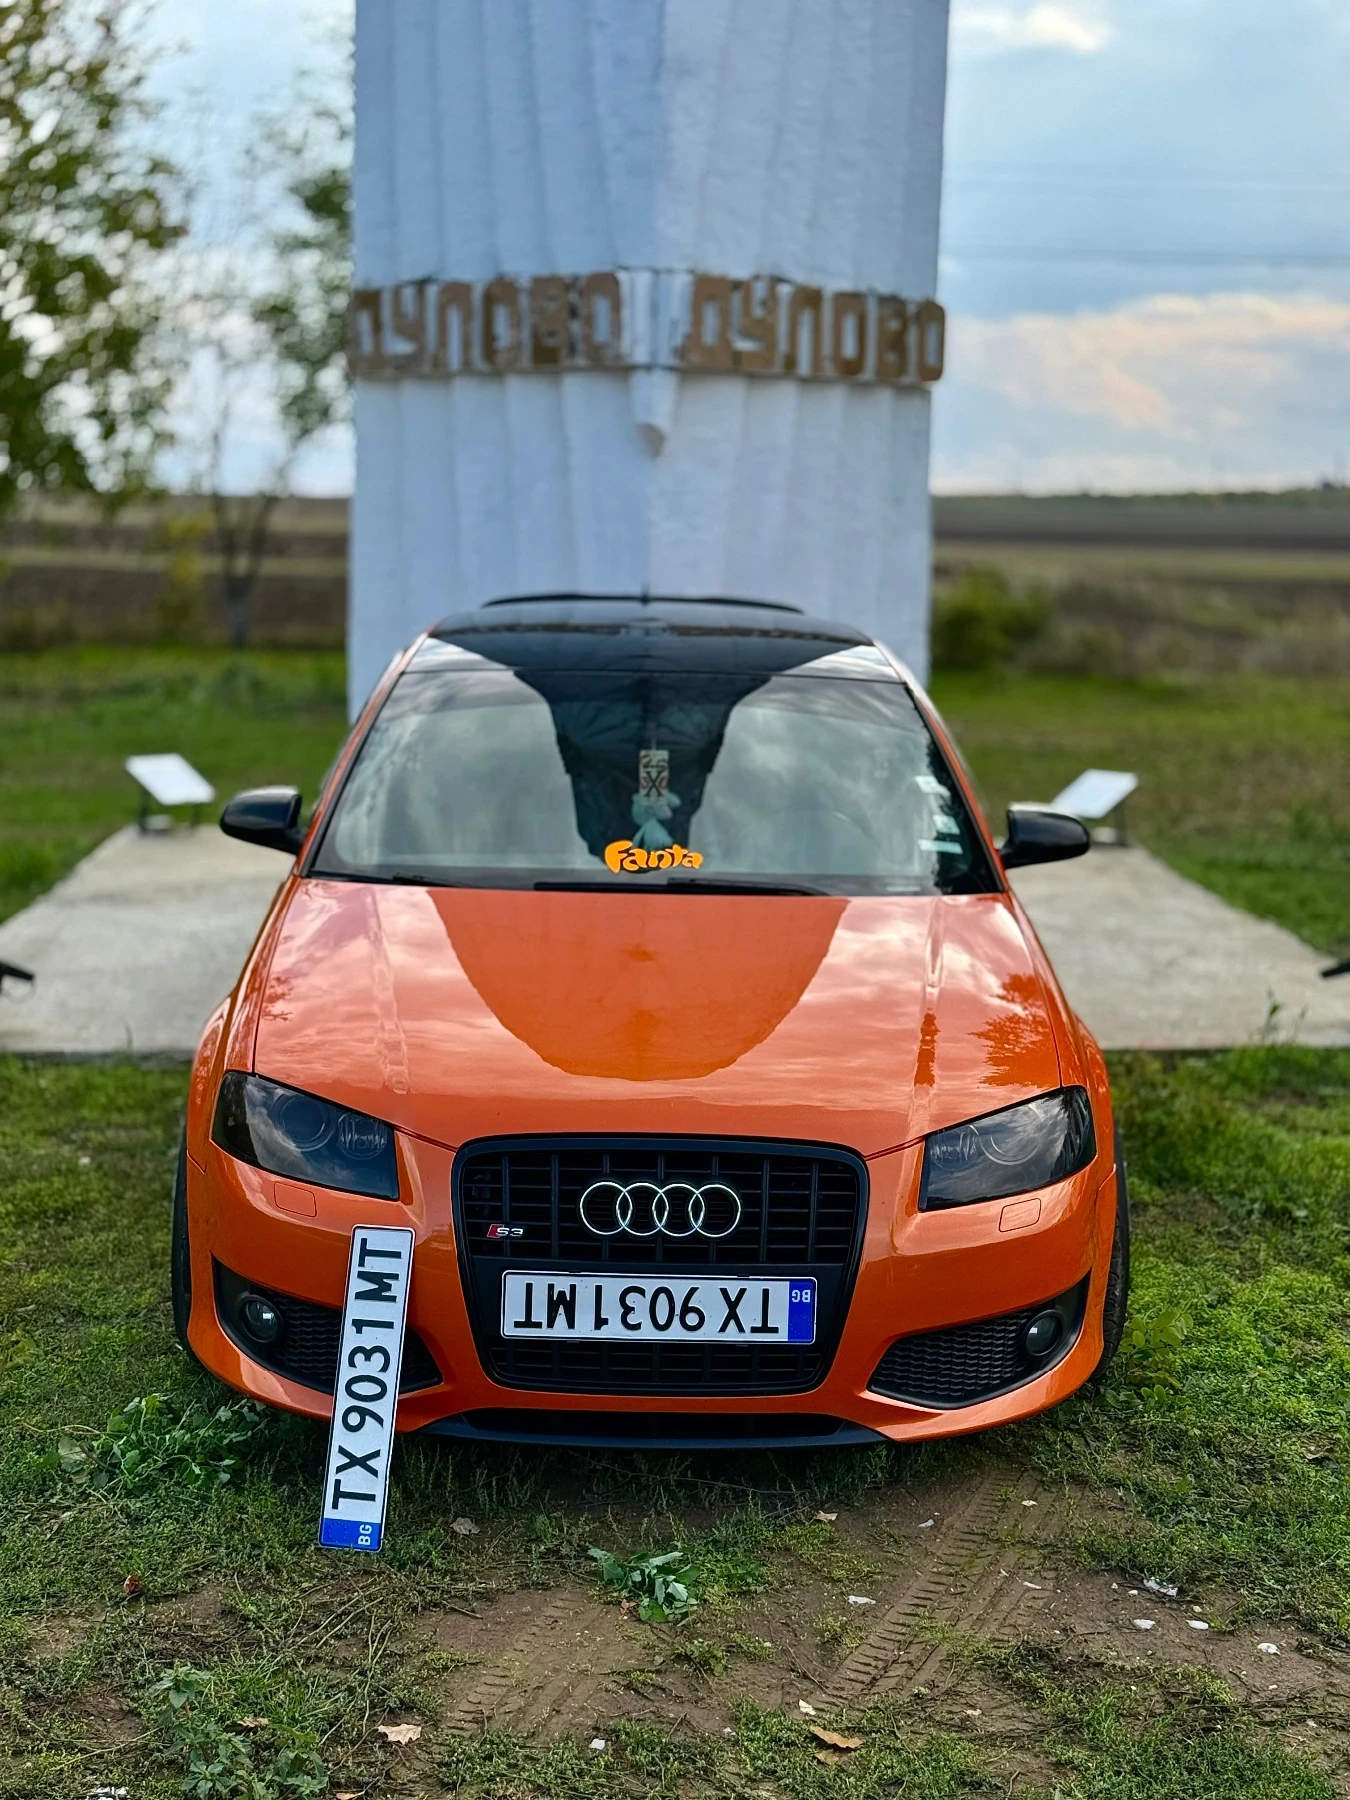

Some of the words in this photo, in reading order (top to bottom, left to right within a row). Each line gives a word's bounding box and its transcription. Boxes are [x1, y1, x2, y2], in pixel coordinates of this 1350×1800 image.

[350, 273, 621, 372] ДУЛОВО
[681, 273, 946, 382] ДУЛОВО
[605, 840, 704, 873] Fanta
[495, 1227, 524, 1237] S3
[354, 1237, 402, 1303] MT
[513, 1282, 577, 1330] MT
[593, 1284, 706, 1332] 9031
[718, 1287, 780, 1334] TX
[791, 1288, 811, 1303] BG
[341, 1317, 395, 1433] 9031
[332, 1444, 381, 1510] TX
[357, 1523, 373, 1546] BG
